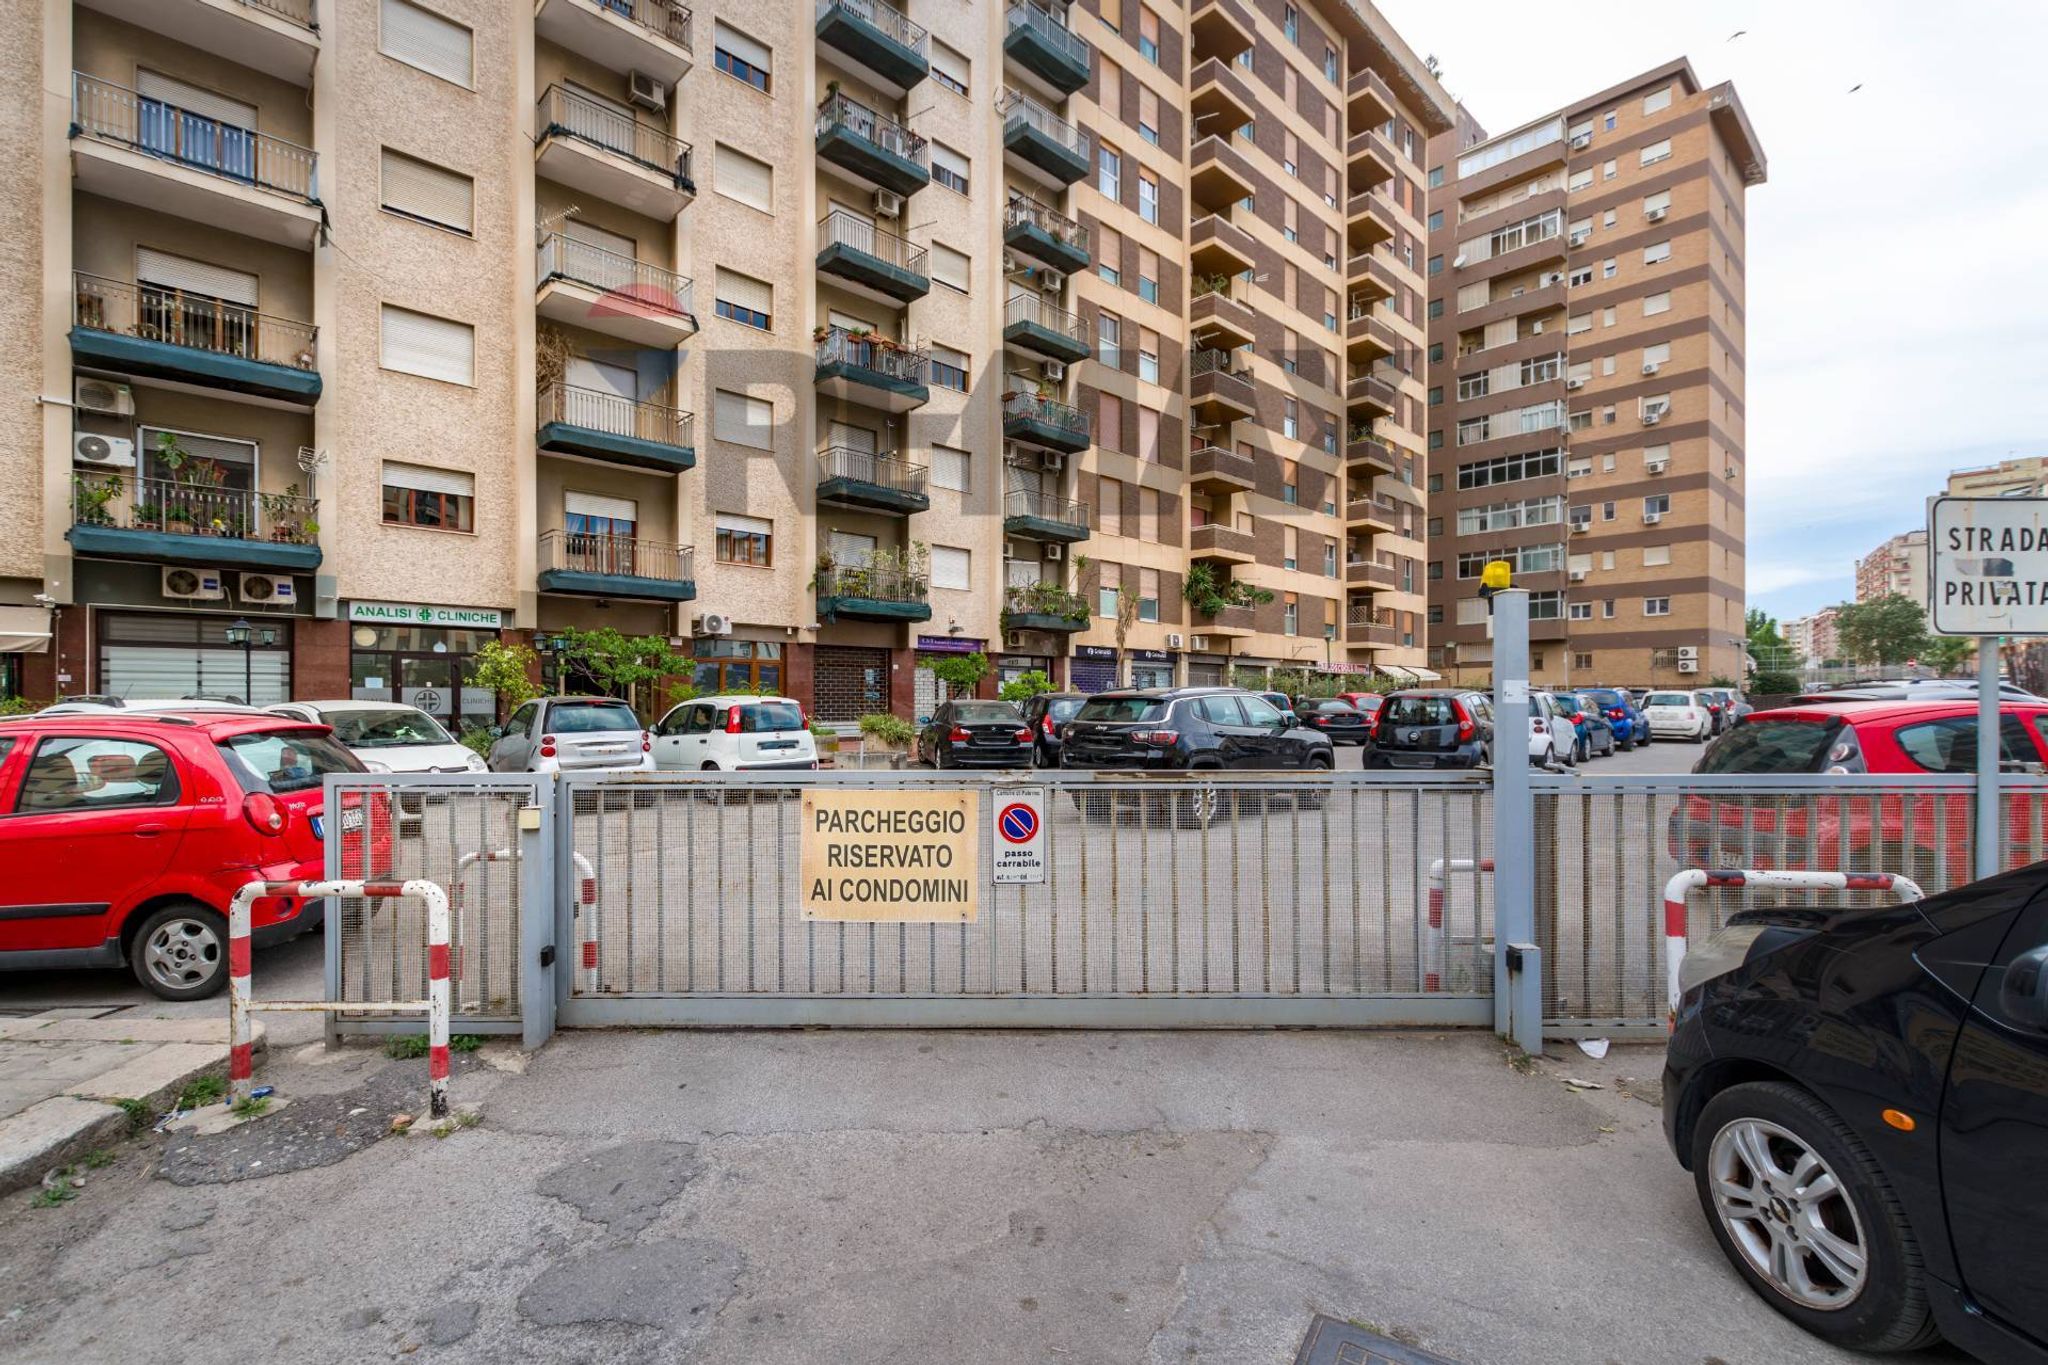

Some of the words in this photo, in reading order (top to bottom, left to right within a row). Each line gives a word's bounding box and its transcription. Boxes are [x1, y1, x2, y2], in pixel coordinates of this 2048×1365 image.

[1948, 527, 2048, 552] STRADA
[354, 605, 412, 619] ANALISI
[437, 610, 498, 624] CLINICHE
[815, 809, 966, 834] PARCHEGGIO
[827, 843, 953, 868] RISERVATO
[996, 859, 1041, 868] carrabile
[1004, 851, 1033, 859] passo
[811, 878, 832, 902] AI
[839, 878, 968, 903] CONDOMINI
